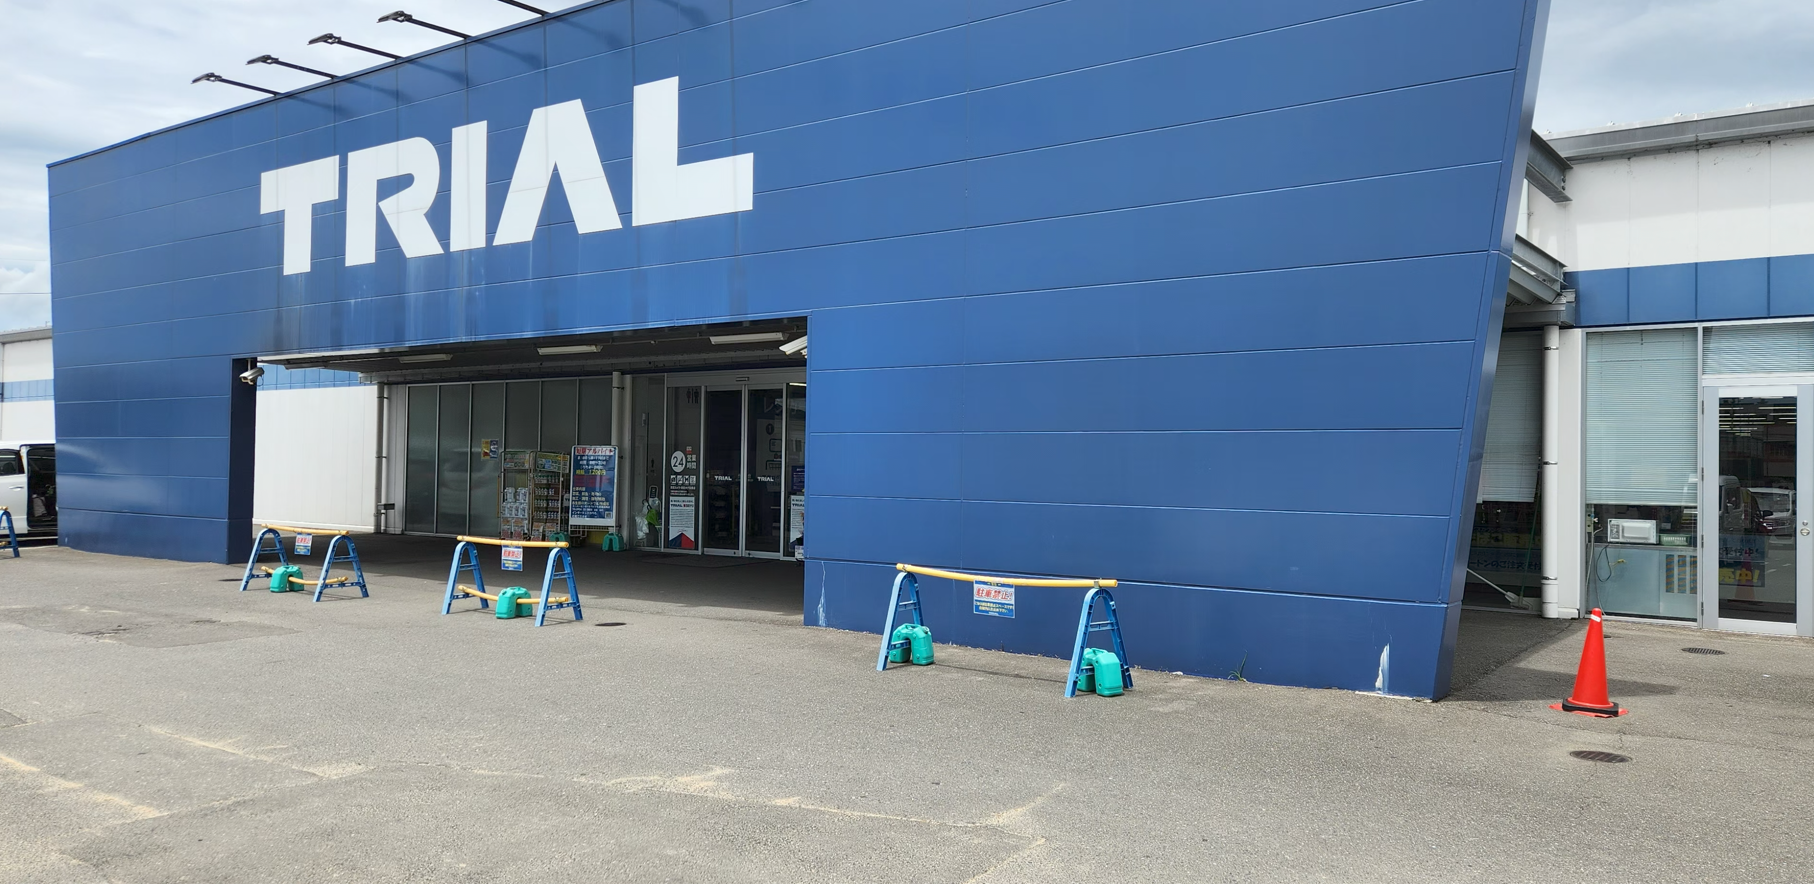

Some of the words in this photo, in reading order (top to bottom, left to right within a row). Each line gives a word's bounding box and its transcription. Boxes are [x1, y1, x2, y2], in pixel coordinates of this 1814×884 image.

[260, 76, 754, 275] TRIAL
[672, 456, 684, 468] 24
[976, 588, 1013, 600] 駐車禁止!
